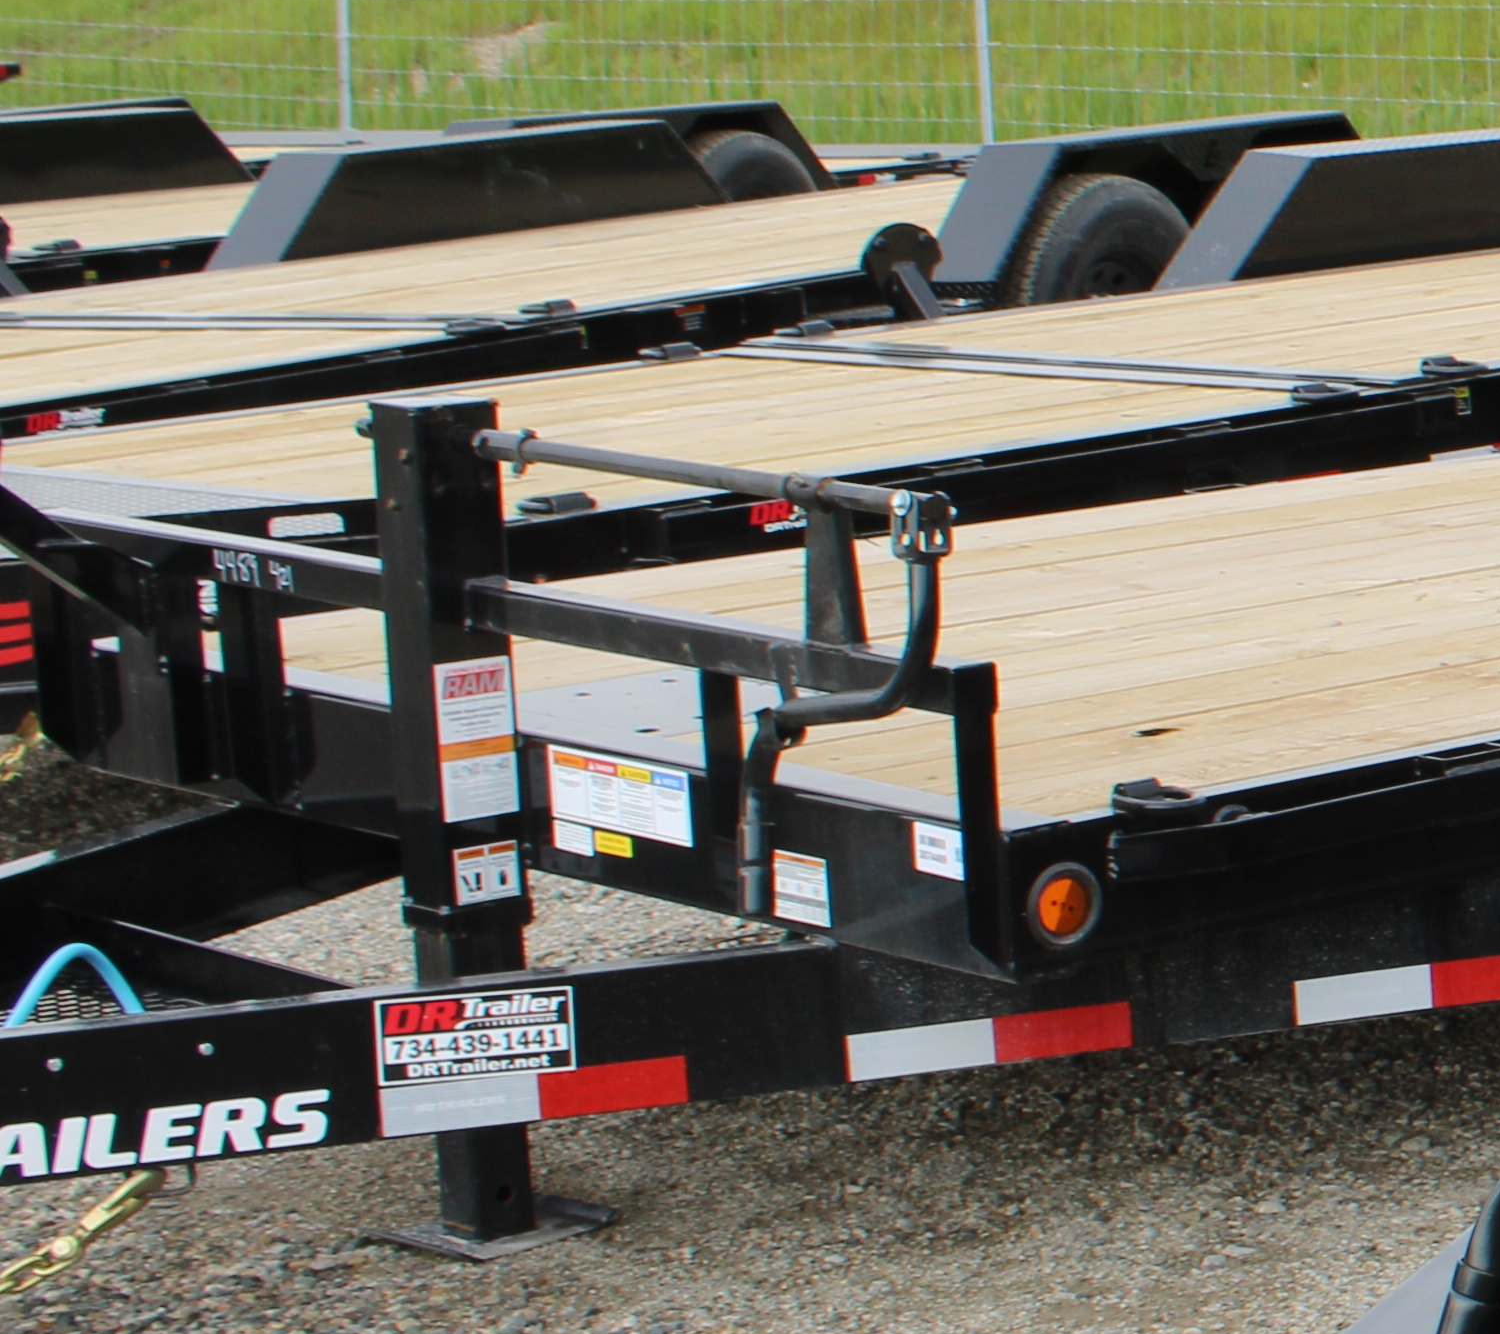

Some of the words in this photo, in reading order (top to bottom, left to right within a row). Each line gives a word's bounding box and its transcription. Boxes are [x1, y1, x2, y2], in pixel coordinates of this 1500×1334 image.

[749, 500, 790, 525] DR
[444, 671, 504, 699] RAM
[384, 1000, 458, 1035] DR
[461, 994, 566, 1018] Trailer
[391, 1028, 561, 1060] 734-439-1441
[406, 1054, 551, 1078] DRTrailer.net
